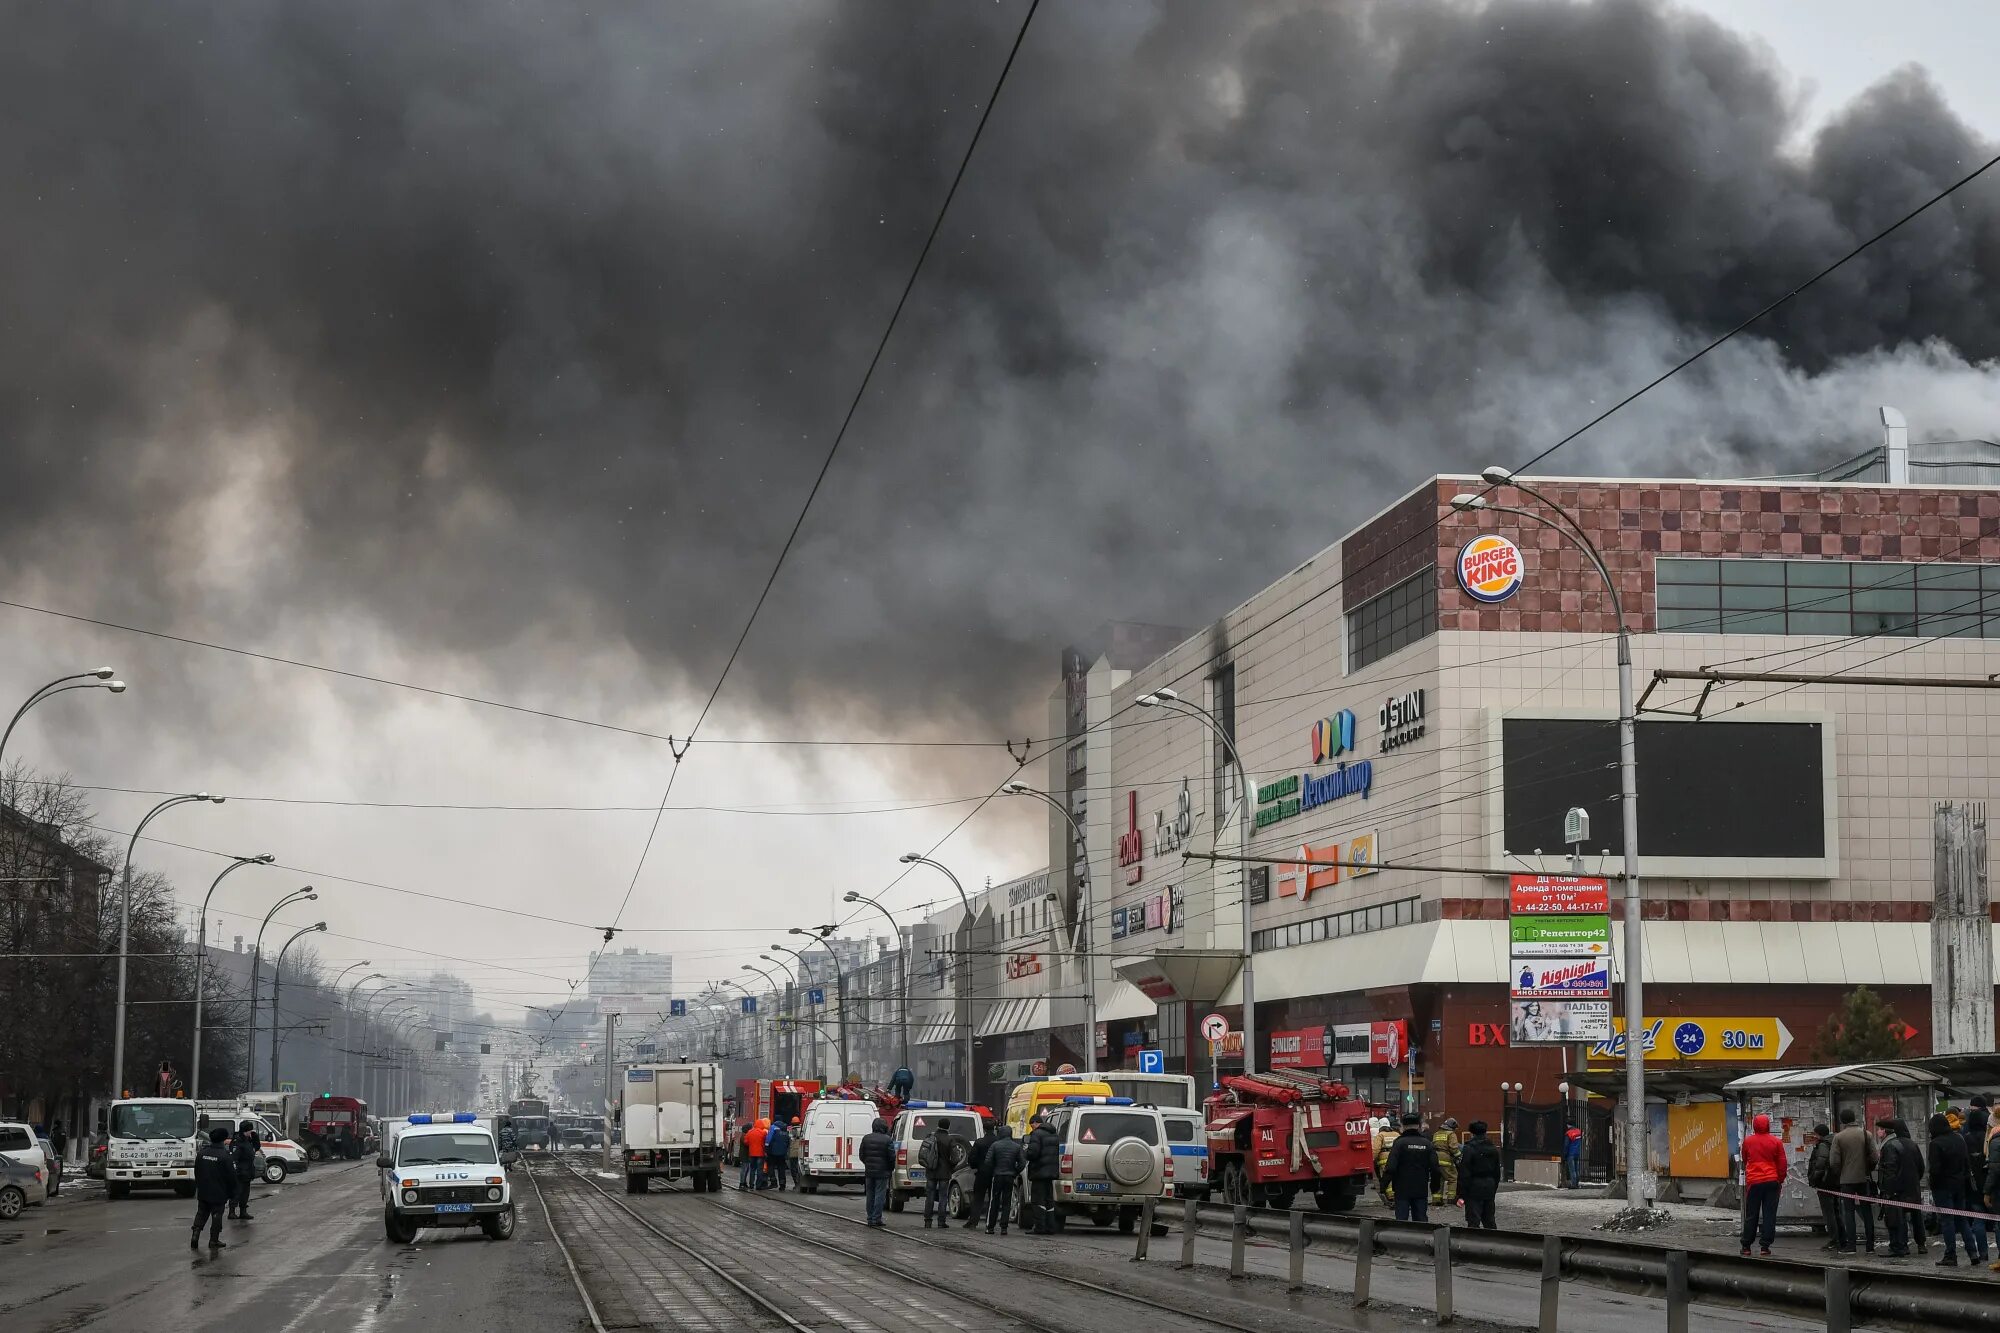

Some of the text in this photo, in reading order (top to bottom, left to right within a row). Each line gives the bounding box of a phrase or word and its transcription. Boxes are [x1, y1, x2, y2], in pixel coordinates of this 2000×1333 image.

[1464, 547, 1514, 670] BURGER
[1467, 659, 1516, 687] KING
[1378, 689, 1423, 732] O'STIN
[1301, 762, 1347, 812] Детский
[1118, 790, 1142, 867] zolla
[1516, 883, 1603, 893] Аренда помещений
[1567, 903, 1603, 911] 44-17-17
[1540, 929, 1605, 938] Репетитор42
[1540, 961, 1596, 986] Highlight
[1469, 1023, 1505, 1045] ВХ
[1682, 1034, 1697, 1043] 24
[1271, 1037, 1301, 1053] SUNLIGHT
[1144, 1053, 1158, 1073] P
[1261, 1129, 1274, 1143] АЦ
[444, 1203, 460, 1212] 0244
